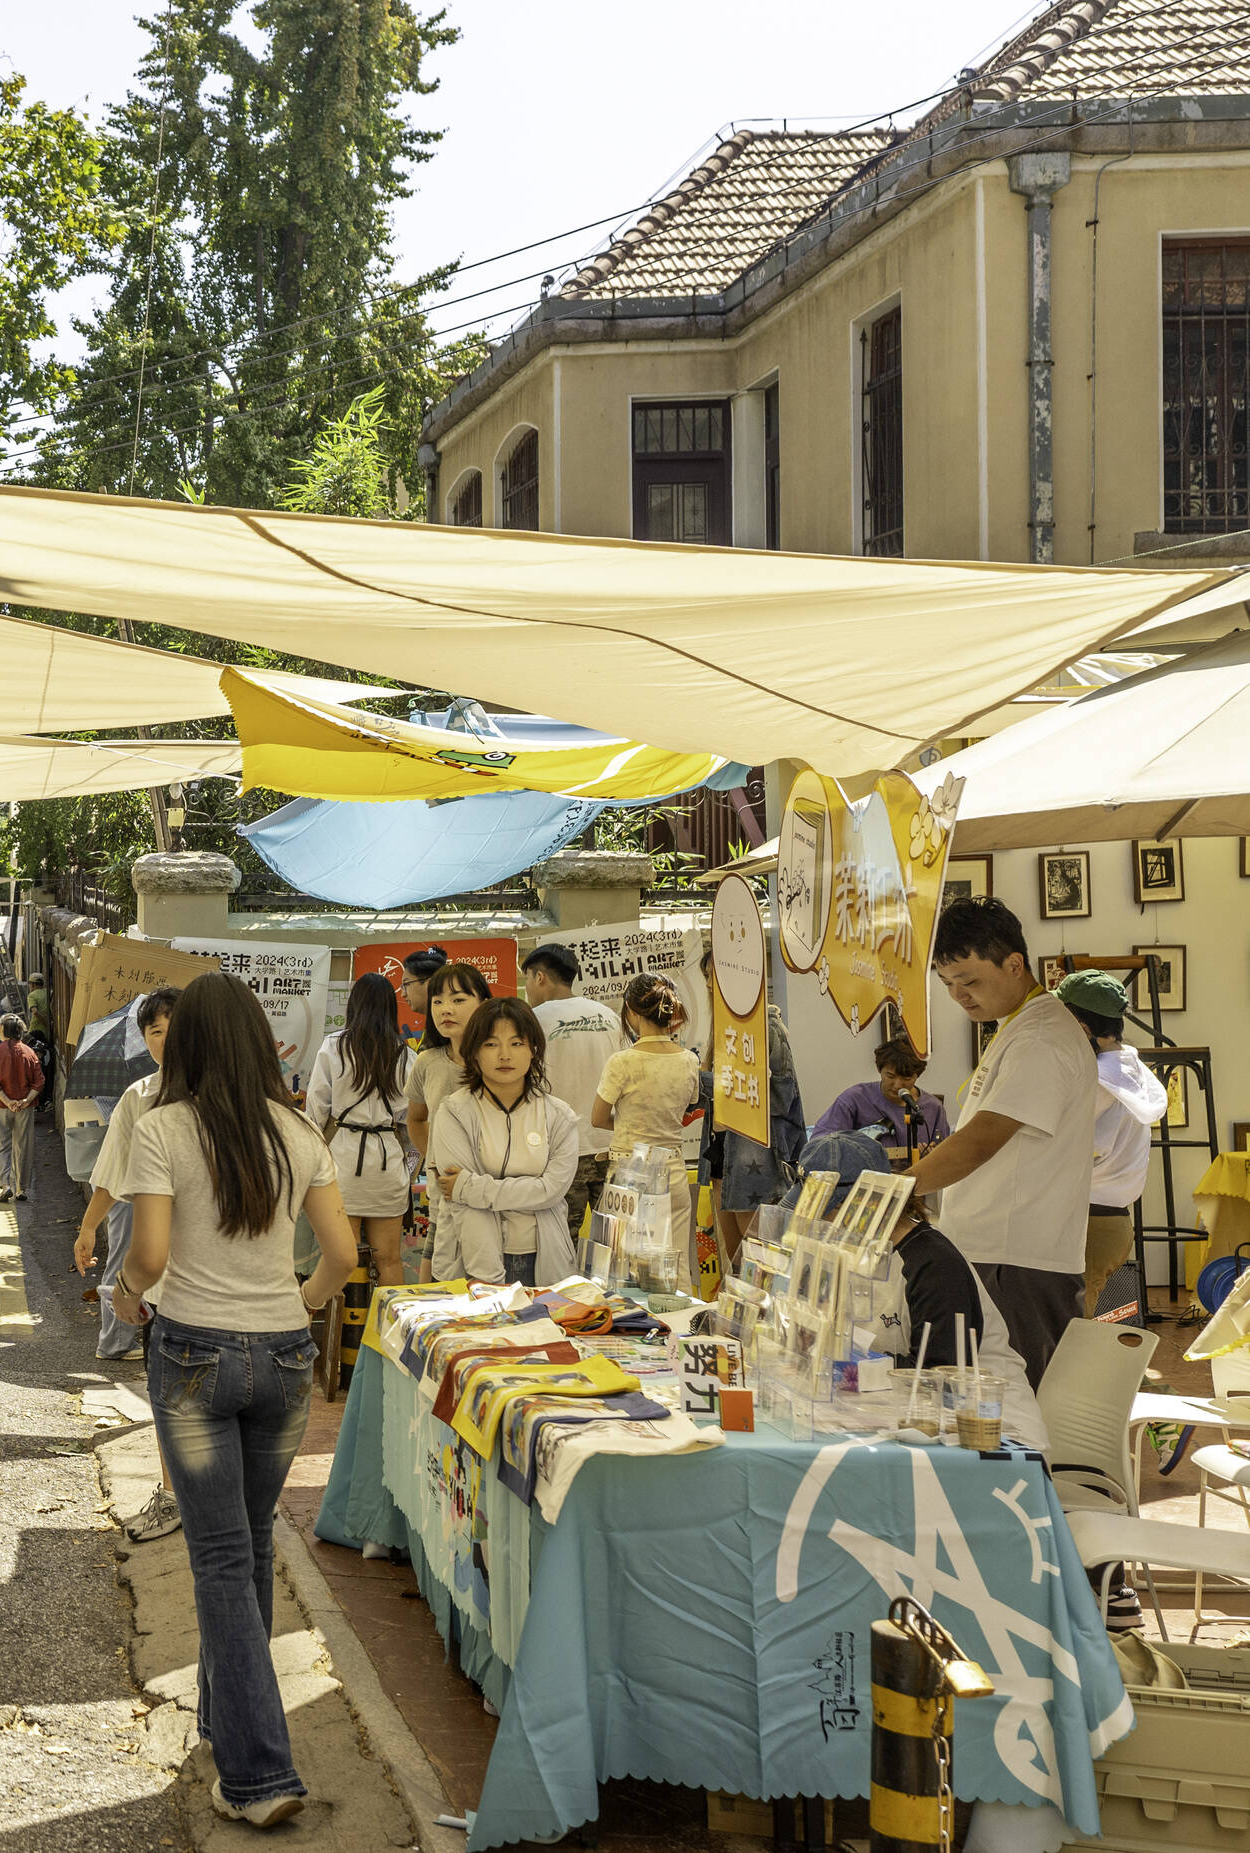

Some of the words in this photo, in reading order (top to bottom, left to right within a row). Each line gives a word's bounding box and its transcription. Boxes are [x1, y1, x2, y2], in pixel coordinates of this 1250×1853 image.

[562, 937, 622, 961] 起来
[647, 952, 675, 965] ART
[578, 956, 644, 981] IQILAI
[273, 977, 302, 989] ART
[582, 980, 628, 996] 2024/09/
[725, 1025, 756, 1066] 文创
